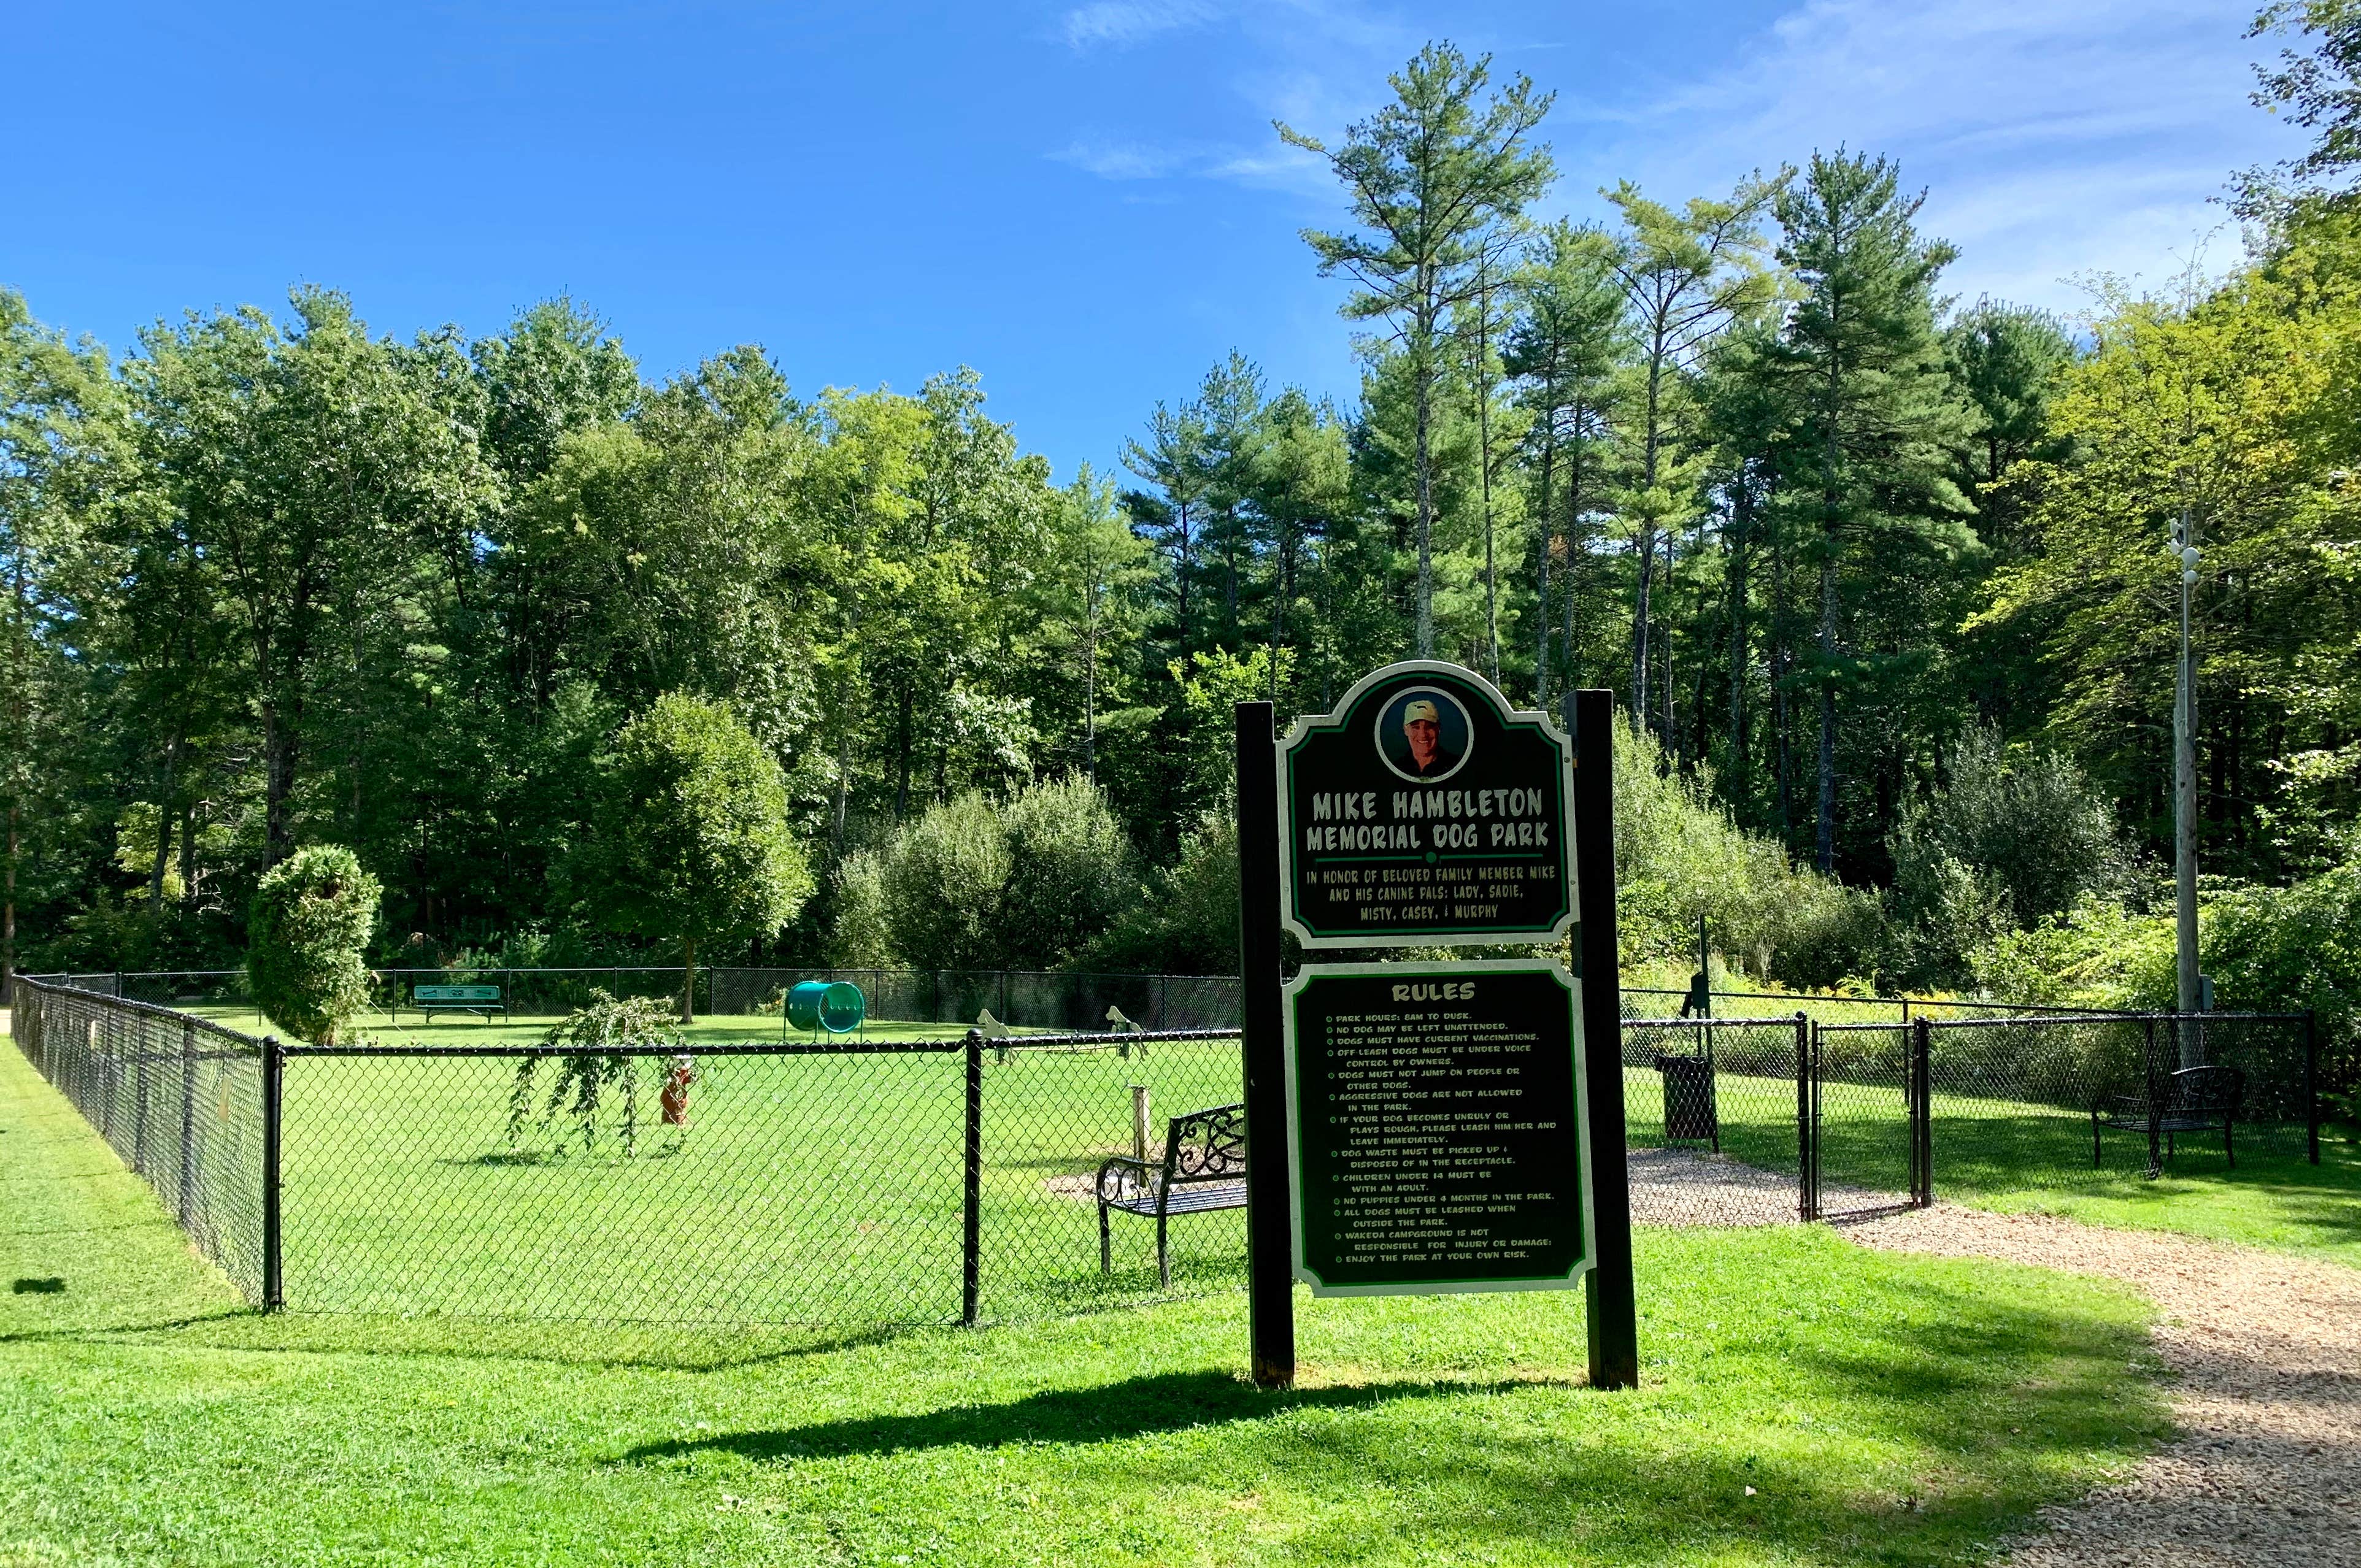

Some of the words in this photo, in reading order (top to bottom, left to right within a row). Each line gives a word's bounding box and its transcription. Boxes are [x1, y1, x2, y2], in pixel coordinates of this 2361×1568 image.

[1313, 792, 1377, 821] MIKE
[1393, 788, 1542, 818] HAMBLETON
[1307, 825, 1420, 851] MEMORIAL
[1433, 823, 1477, 848] DOG
[1491, 822, 1548, 846] PARK
[1307, 871, 1317, 883] IN
[1323, 870, 1358, 883] HONOR
[1365, 870, 1377, 883] OF
[1383, 869, 1430, 882] BELOVED
[1436, 868, 1473, 882] FAMILY
[1479, 867, 1523, 880] MEMBER
[1530, 866, 1555, 878] MIKE
[1330, 888, 1349, 901] AND
[1356, 888, 1373, 901] HIS
[1378, 887, 1414, 901] CANINE
[1420, 886, 1447, 899] PALS:
[1454, 885, 1483, 899] LADY,
[1489, 885, 1523, 898] SADIE,
[1361, 907, 1396, 921] MISTY,
[1402, 905, 1438, 920] CASEY,
[1455, 904, 1498, 918] MURPHY
[1392, 982, 1475, 1001] RULES
